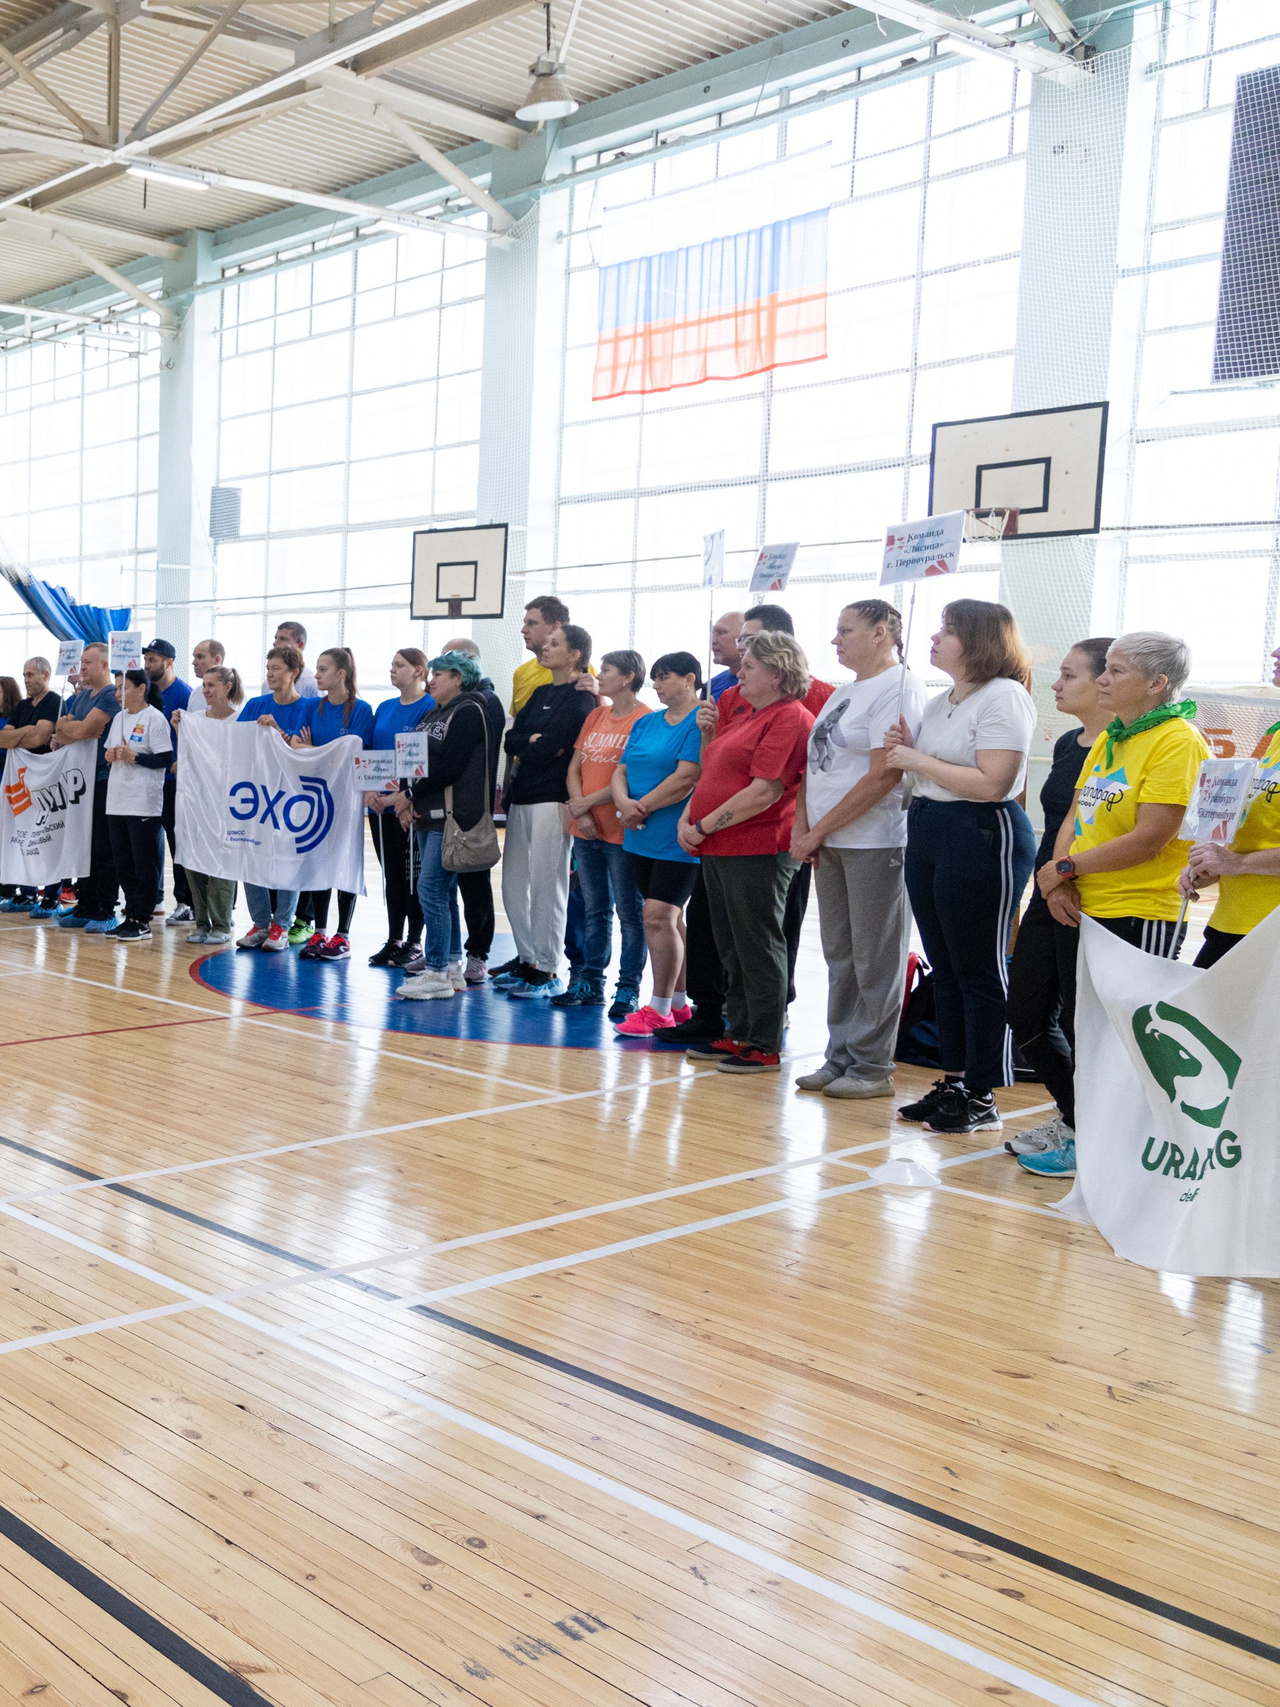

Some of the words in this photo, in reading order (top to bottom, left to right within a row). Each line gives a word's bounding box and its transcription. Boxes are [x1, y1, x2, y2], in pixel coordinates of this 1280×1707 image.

[907, 529, 944, 544] Команда
[904, 542, 944, 554] «Лисица»
[895, 551, 955, 568] Первоуральск
[1211, 776, 1238, 788] Команда
[229, 780, 317, 833] ЭХО
